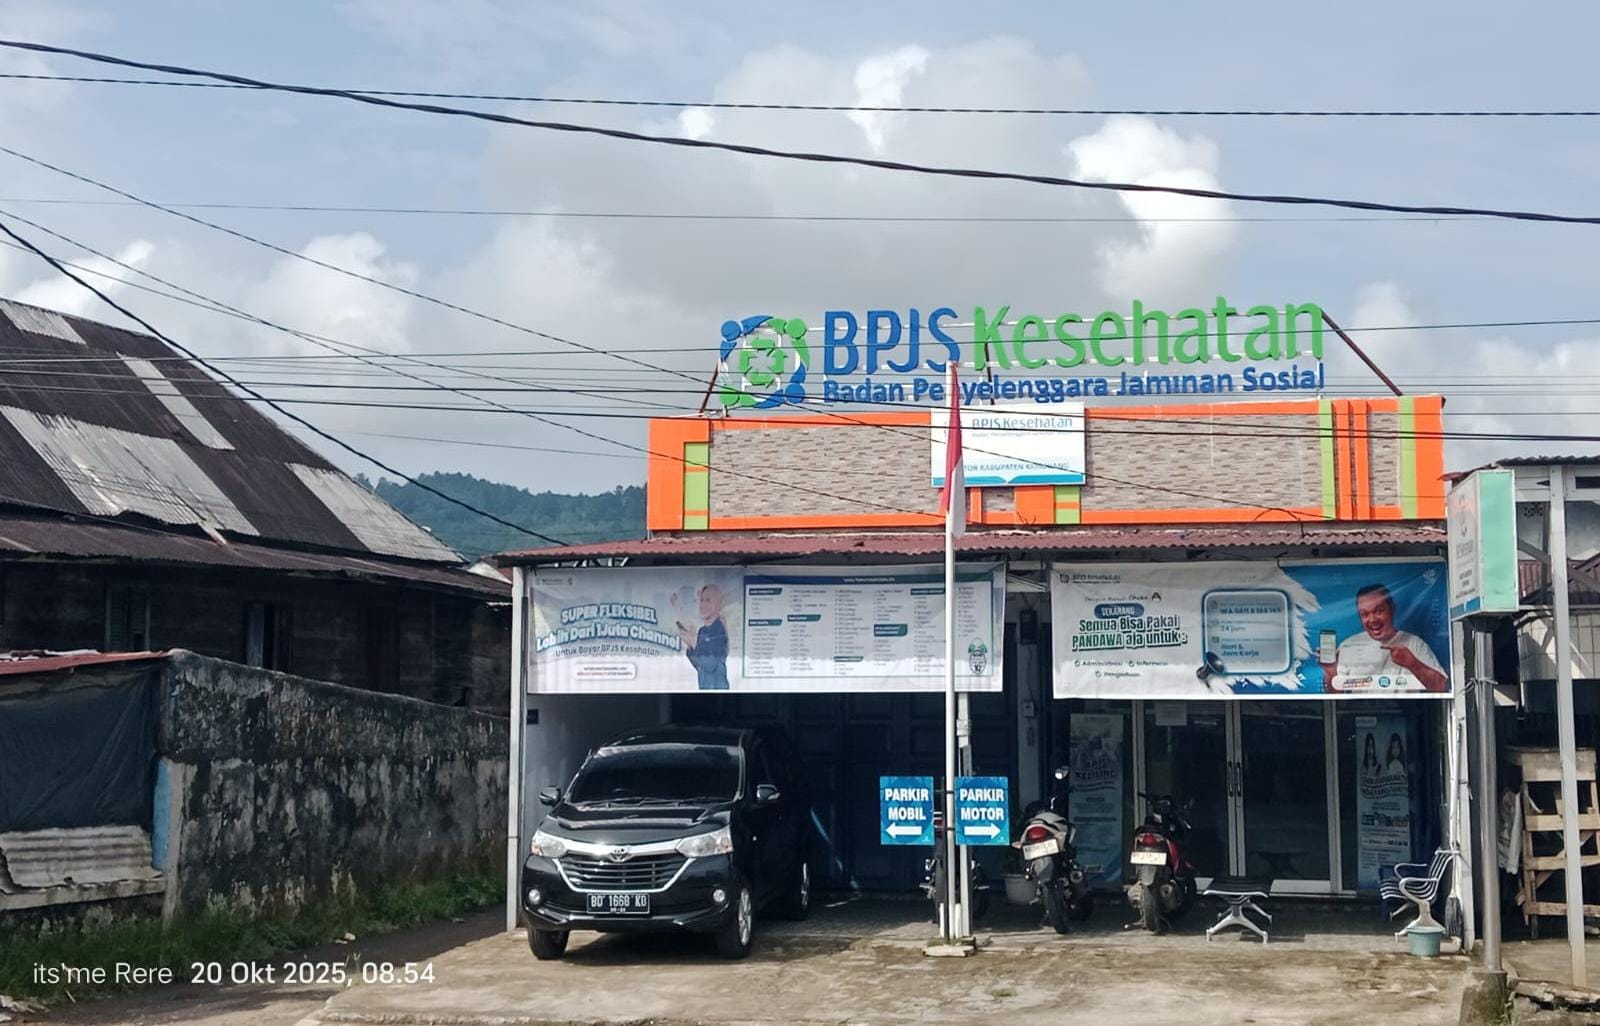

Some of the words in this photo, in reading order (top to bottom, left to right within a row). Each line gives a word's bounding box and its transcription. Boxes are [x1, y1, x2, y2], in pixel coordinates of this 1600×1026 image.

[823, 307, 961, 376] BPJS
[973, 296, 1324, 372] Kesehatan
[823, 377, 904, 403] Badan
[913, 373, 1108, 406] Peyelenggara
[1116, 371, 1233, 396] Jaminan
[1242, 361, 1325, 391] Sosial
[1003, 416, 1073, 429] Kesehatan
[561, 604, 598, 624] SUPER
[600, 603, 658, 624] FLEKSIBEL
[1101, 607, 1136, 617] SEKARANG
[1079, 619, 1118, 632] Semua
[1120, 616, 1144, 631] Bisa
[1146, 614, 1179, 630] Pakai
[1072, 633, 1123, 648] PANDAWA
[1146, 630, 1179, 644] untuk
[885, 788, 929, 801] PARKIR
[960, 788, 1004, 801] PARKIR
[888, 807, 926, 820] MOBIL
[961, 807, 1004, 820] MOTOR
